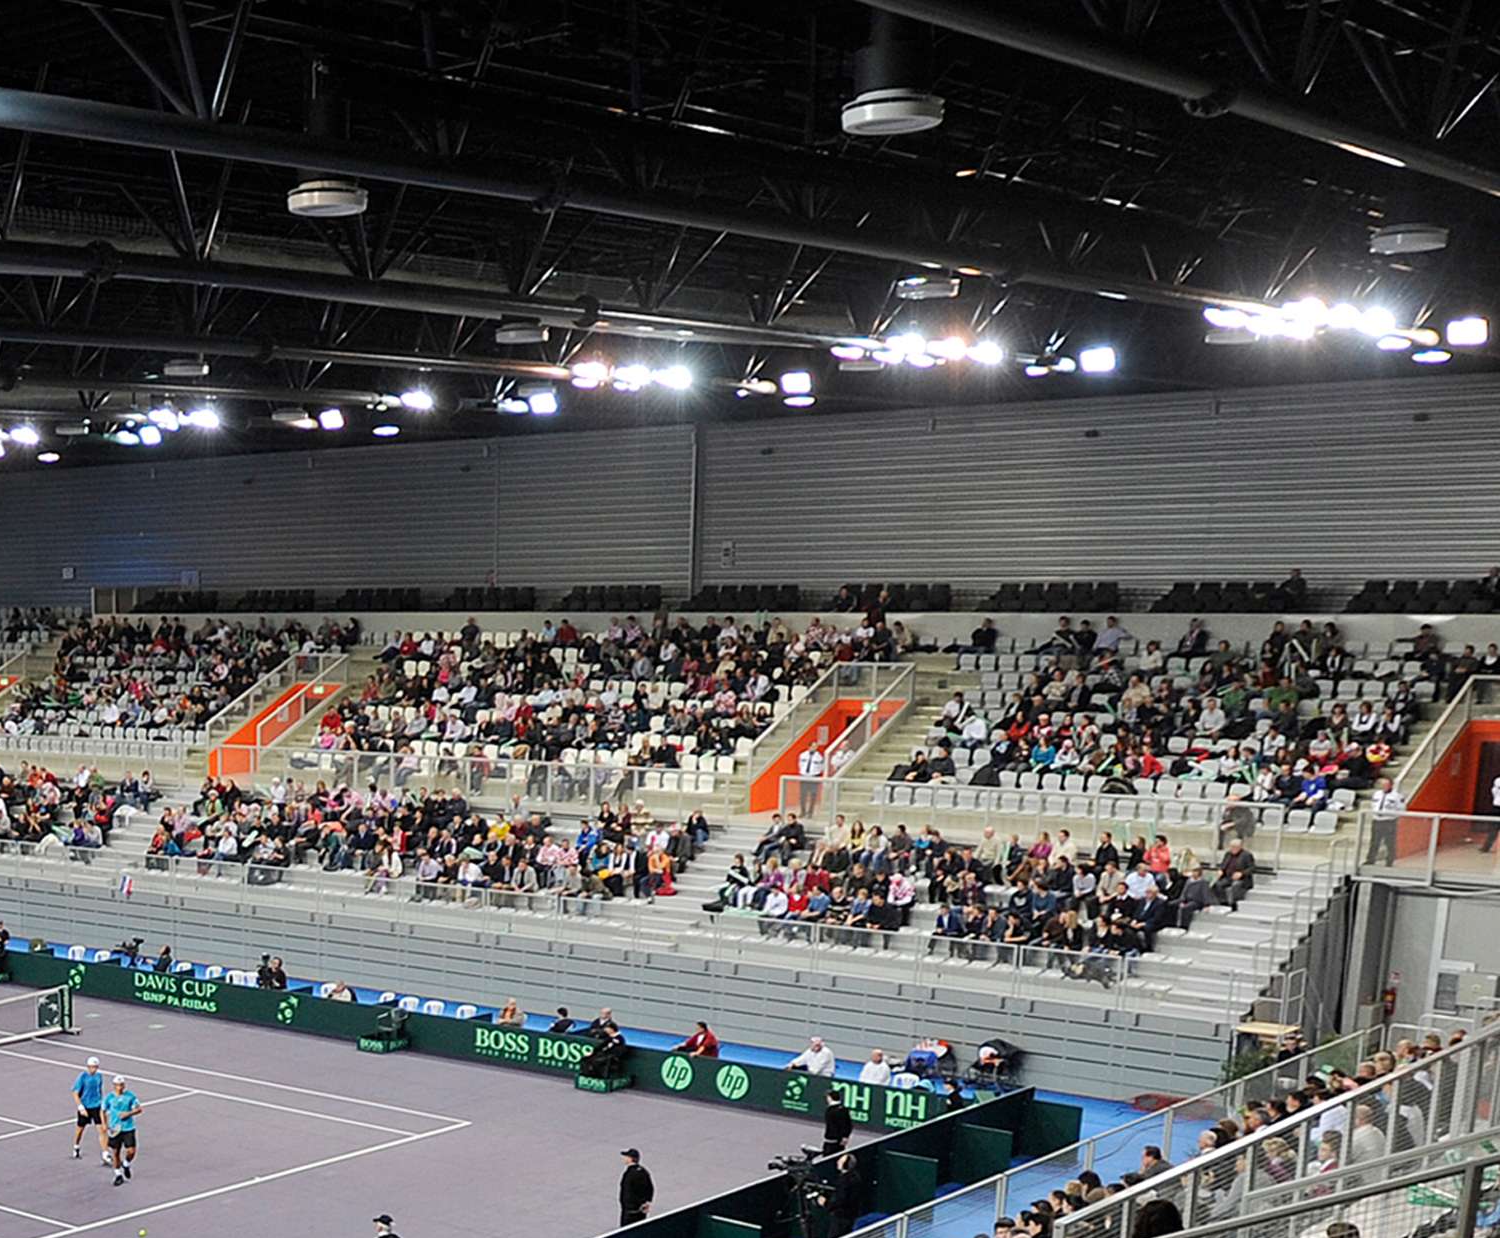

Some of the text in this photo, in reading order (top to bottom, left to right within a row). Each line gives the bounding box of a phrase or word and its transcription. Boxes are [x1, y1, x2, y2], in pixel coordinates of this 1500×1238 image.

[135, 971, 218, 998] DAVIS CUP
[475, 1027, 529, 1054] BOSS
[664, 1058, 689, 1088] hp
[719, 1067, 746, 1097] hp
[885, 1090, 927, 1120] nH
